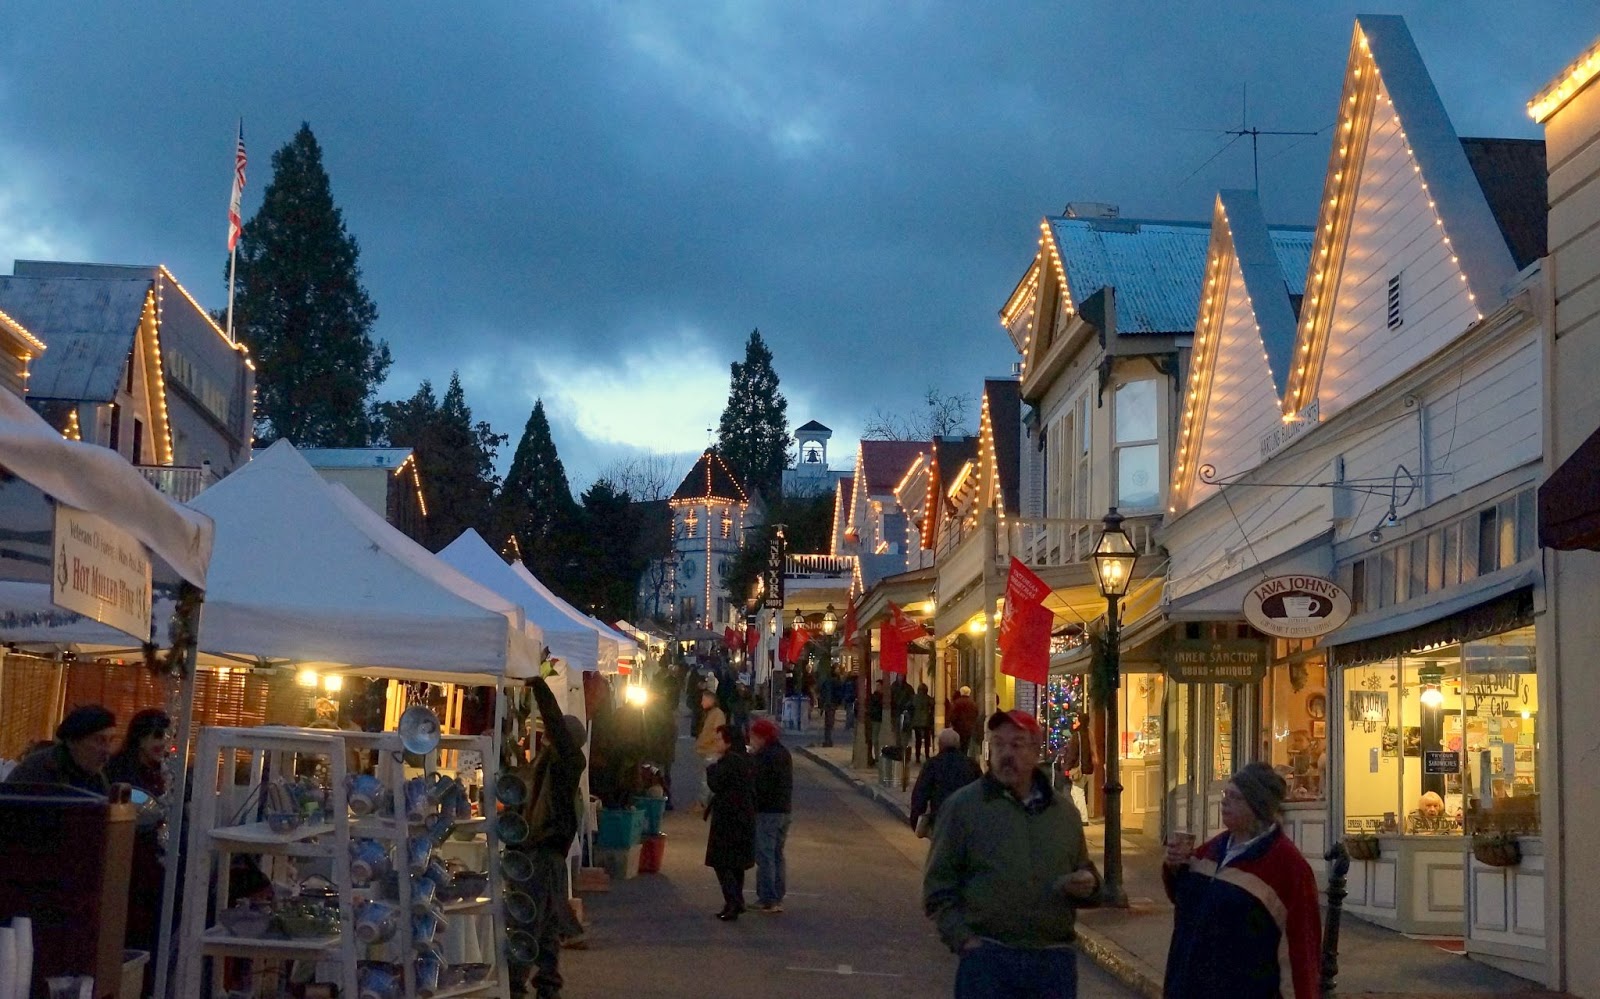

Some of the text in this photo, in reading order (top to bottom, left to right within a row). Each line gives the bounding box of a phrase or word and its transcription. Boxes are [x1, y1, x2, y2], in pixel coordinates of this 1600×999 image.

[69, 518, 92, 546] Veterans
[768, 546, 781, 567] NEW
[72, 556, 90, 595] HOT
[90, 565, 118, 606] MULLED
[119, 578, 135, 615] WINE
[769, 570, 779, 599] YORK
[1253, 577, 1340, 603] JAVA JOHN'S
[765, 599, 782, 607] SHOPS
[1175, 651, 1258, 663] INNER SANCTUM
[1215, 666, 1252, 677] ANTIQUES
[1490, 696, 1509, 717] Cafe
